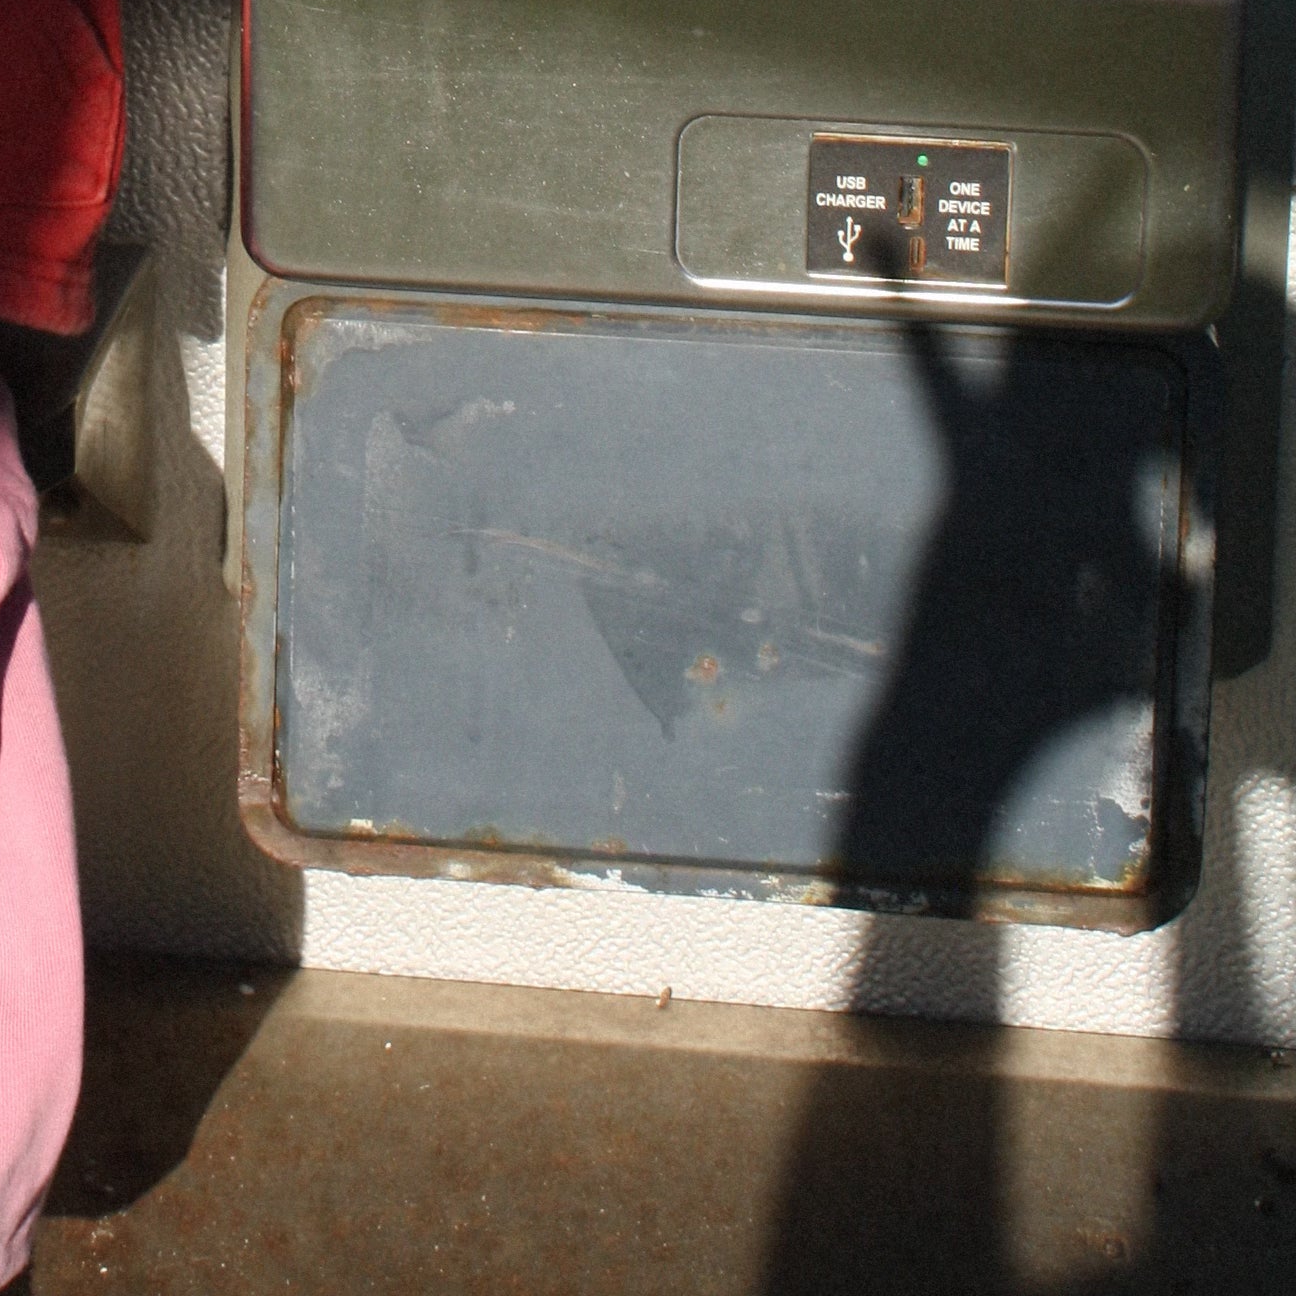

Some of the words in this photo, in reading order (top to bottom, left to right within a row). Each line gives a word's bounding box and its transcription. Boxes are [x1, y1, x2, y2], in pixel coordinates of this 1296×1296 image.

[836, 175, 866, 190] USB
[949, 182, 981, 196] ONE
[815, 193, 887, 210] CHARGER
[938, 199, 991, 215] DEVICE
[947, 219, 967, 233] AT
[969, 220, 981, 233] A
[946, 236, 980, 251] TIME
